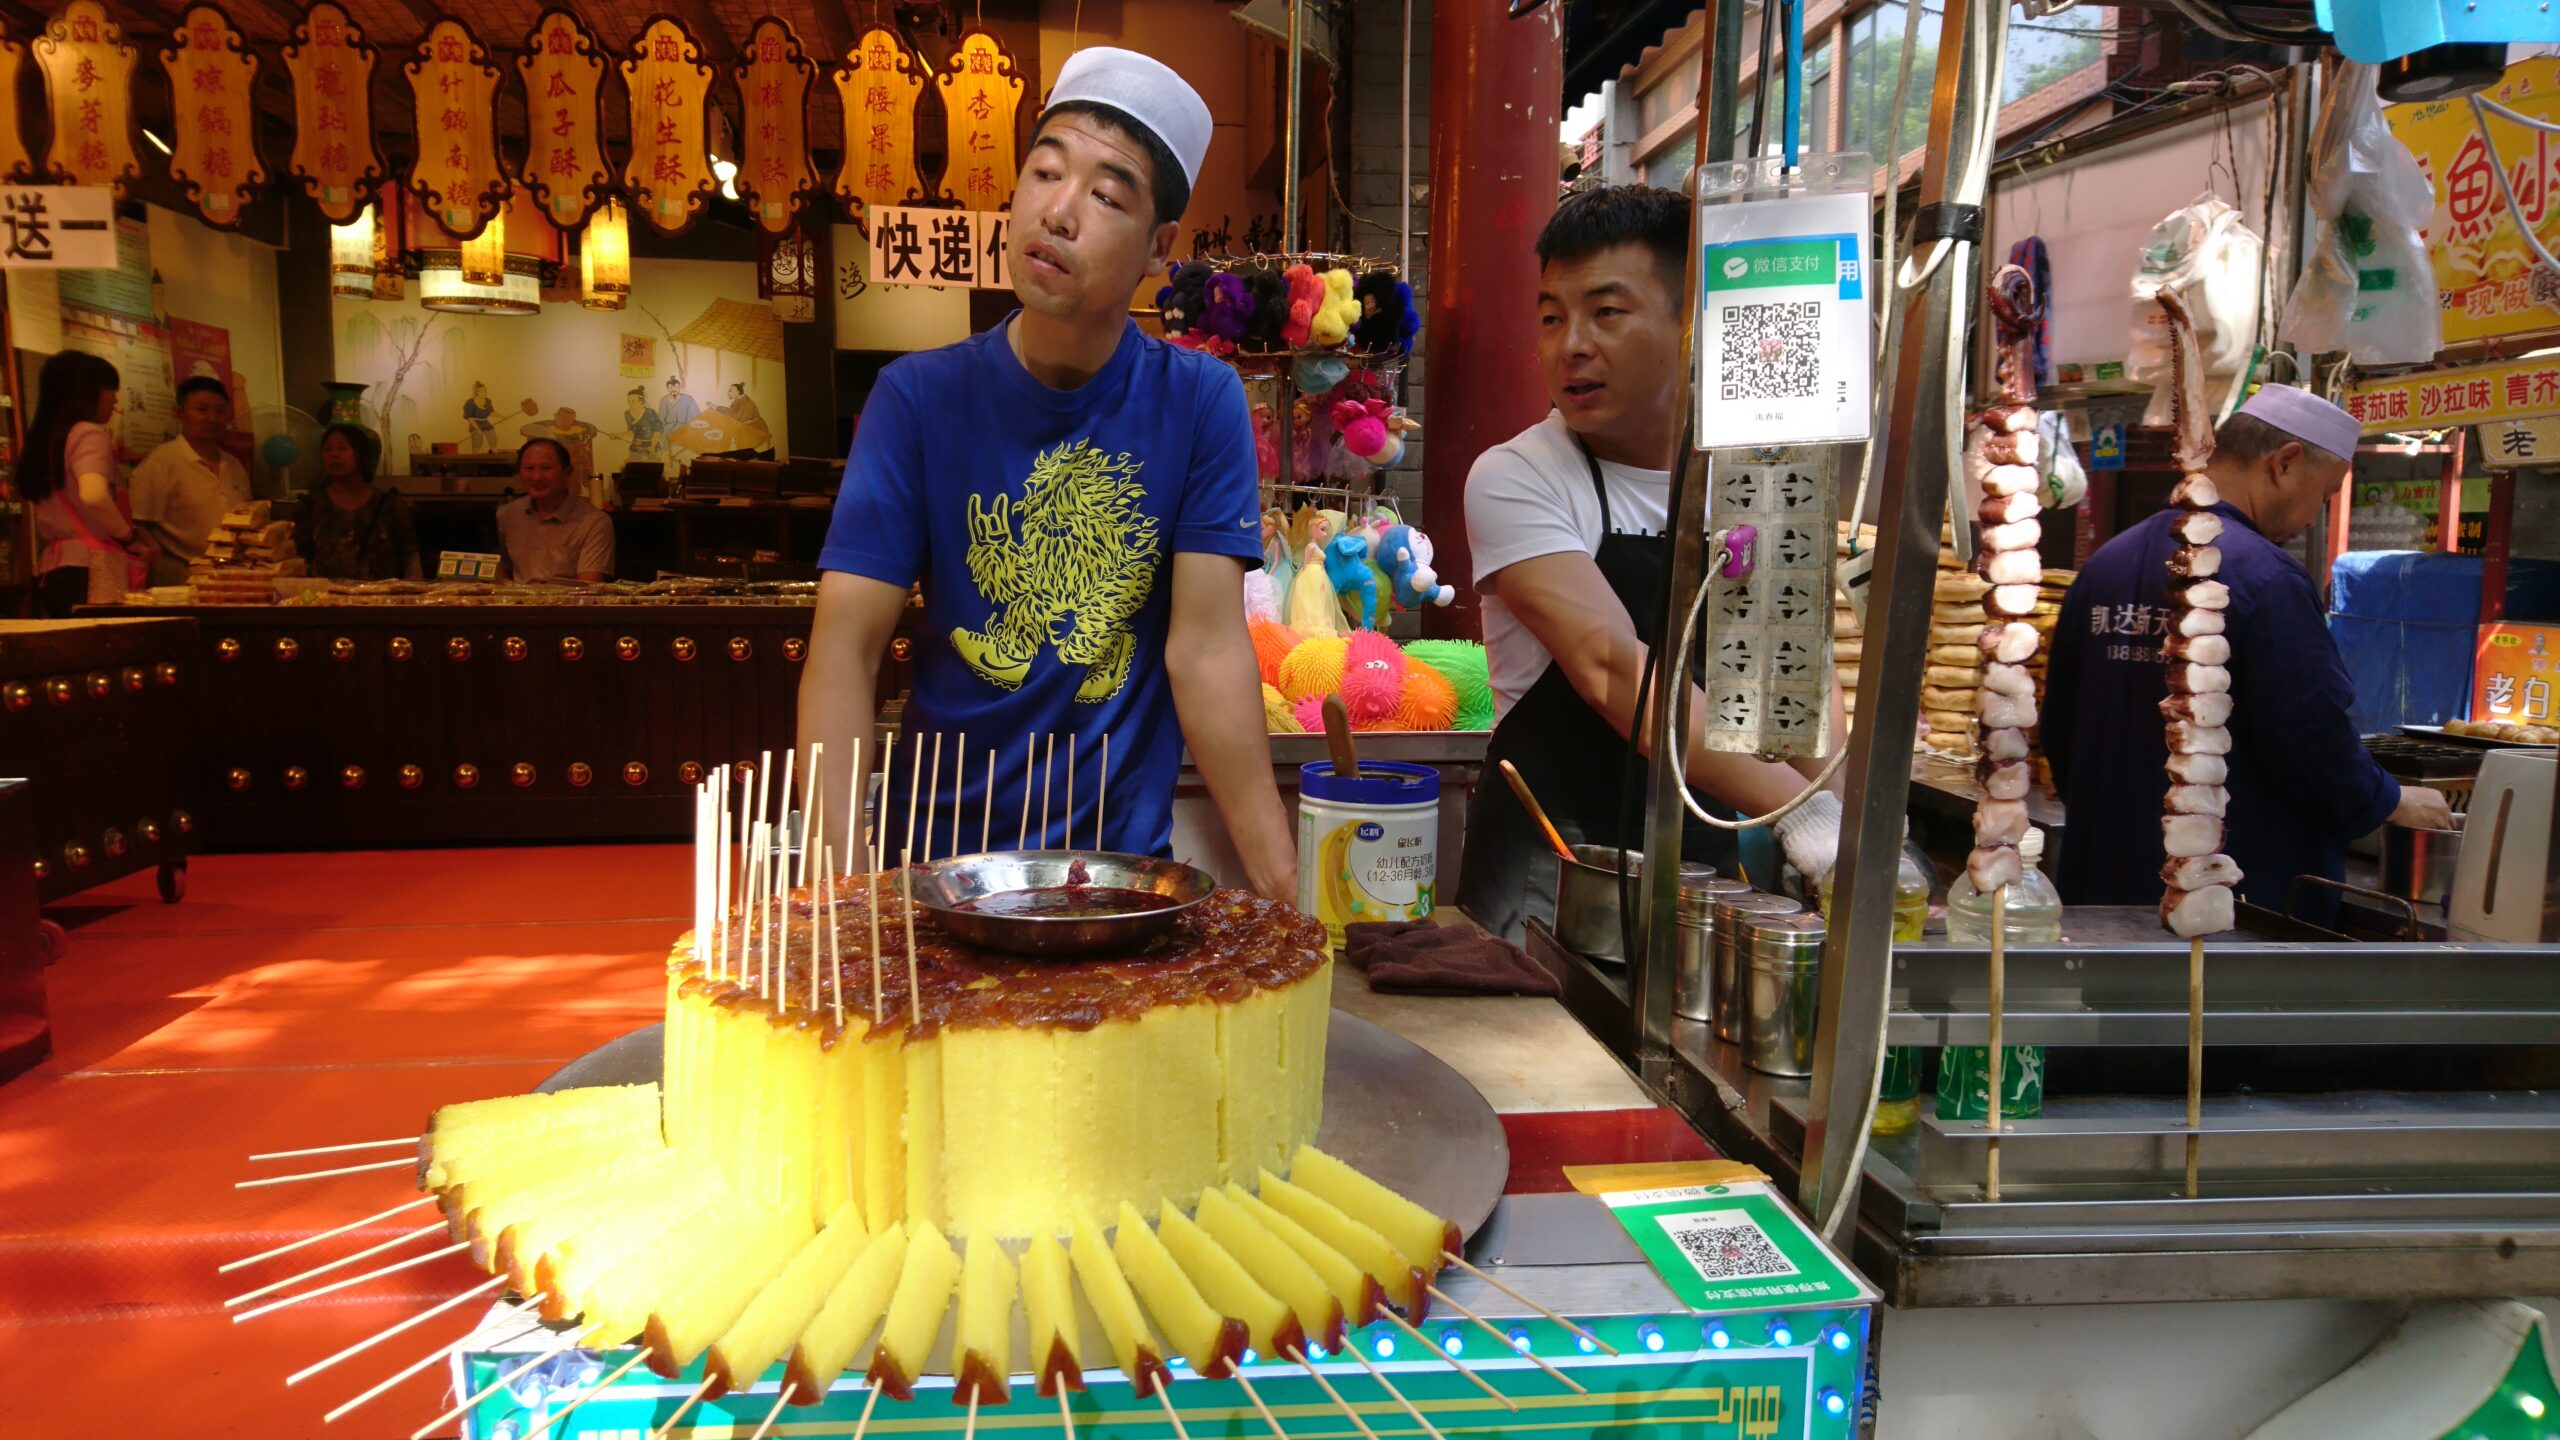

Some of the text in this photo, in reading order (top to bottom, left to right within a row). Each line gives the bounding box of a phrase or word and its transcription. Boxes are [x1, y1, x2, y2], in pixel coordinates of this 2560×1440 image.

[546, 69, 582, 179] 瓜子酥
[653, 76, 687, 186] 花生酥
[863, 85, 897, 193] 腰果酥
[967, 88, 999, 198] 杏仁酥
[1, 191, 108, 261] 送一
[1753, 254, 1820, 274] 微信支付
[2349, 390, 2408, 422] 番茄味
[2420, 379, 2492, 417] 沙拉味
[2502, 429, 2537, 457] 老
[1421, 893, 1433, 917] 3
[1704, 1280, 1831, 1300] 推荐使用微信支付
